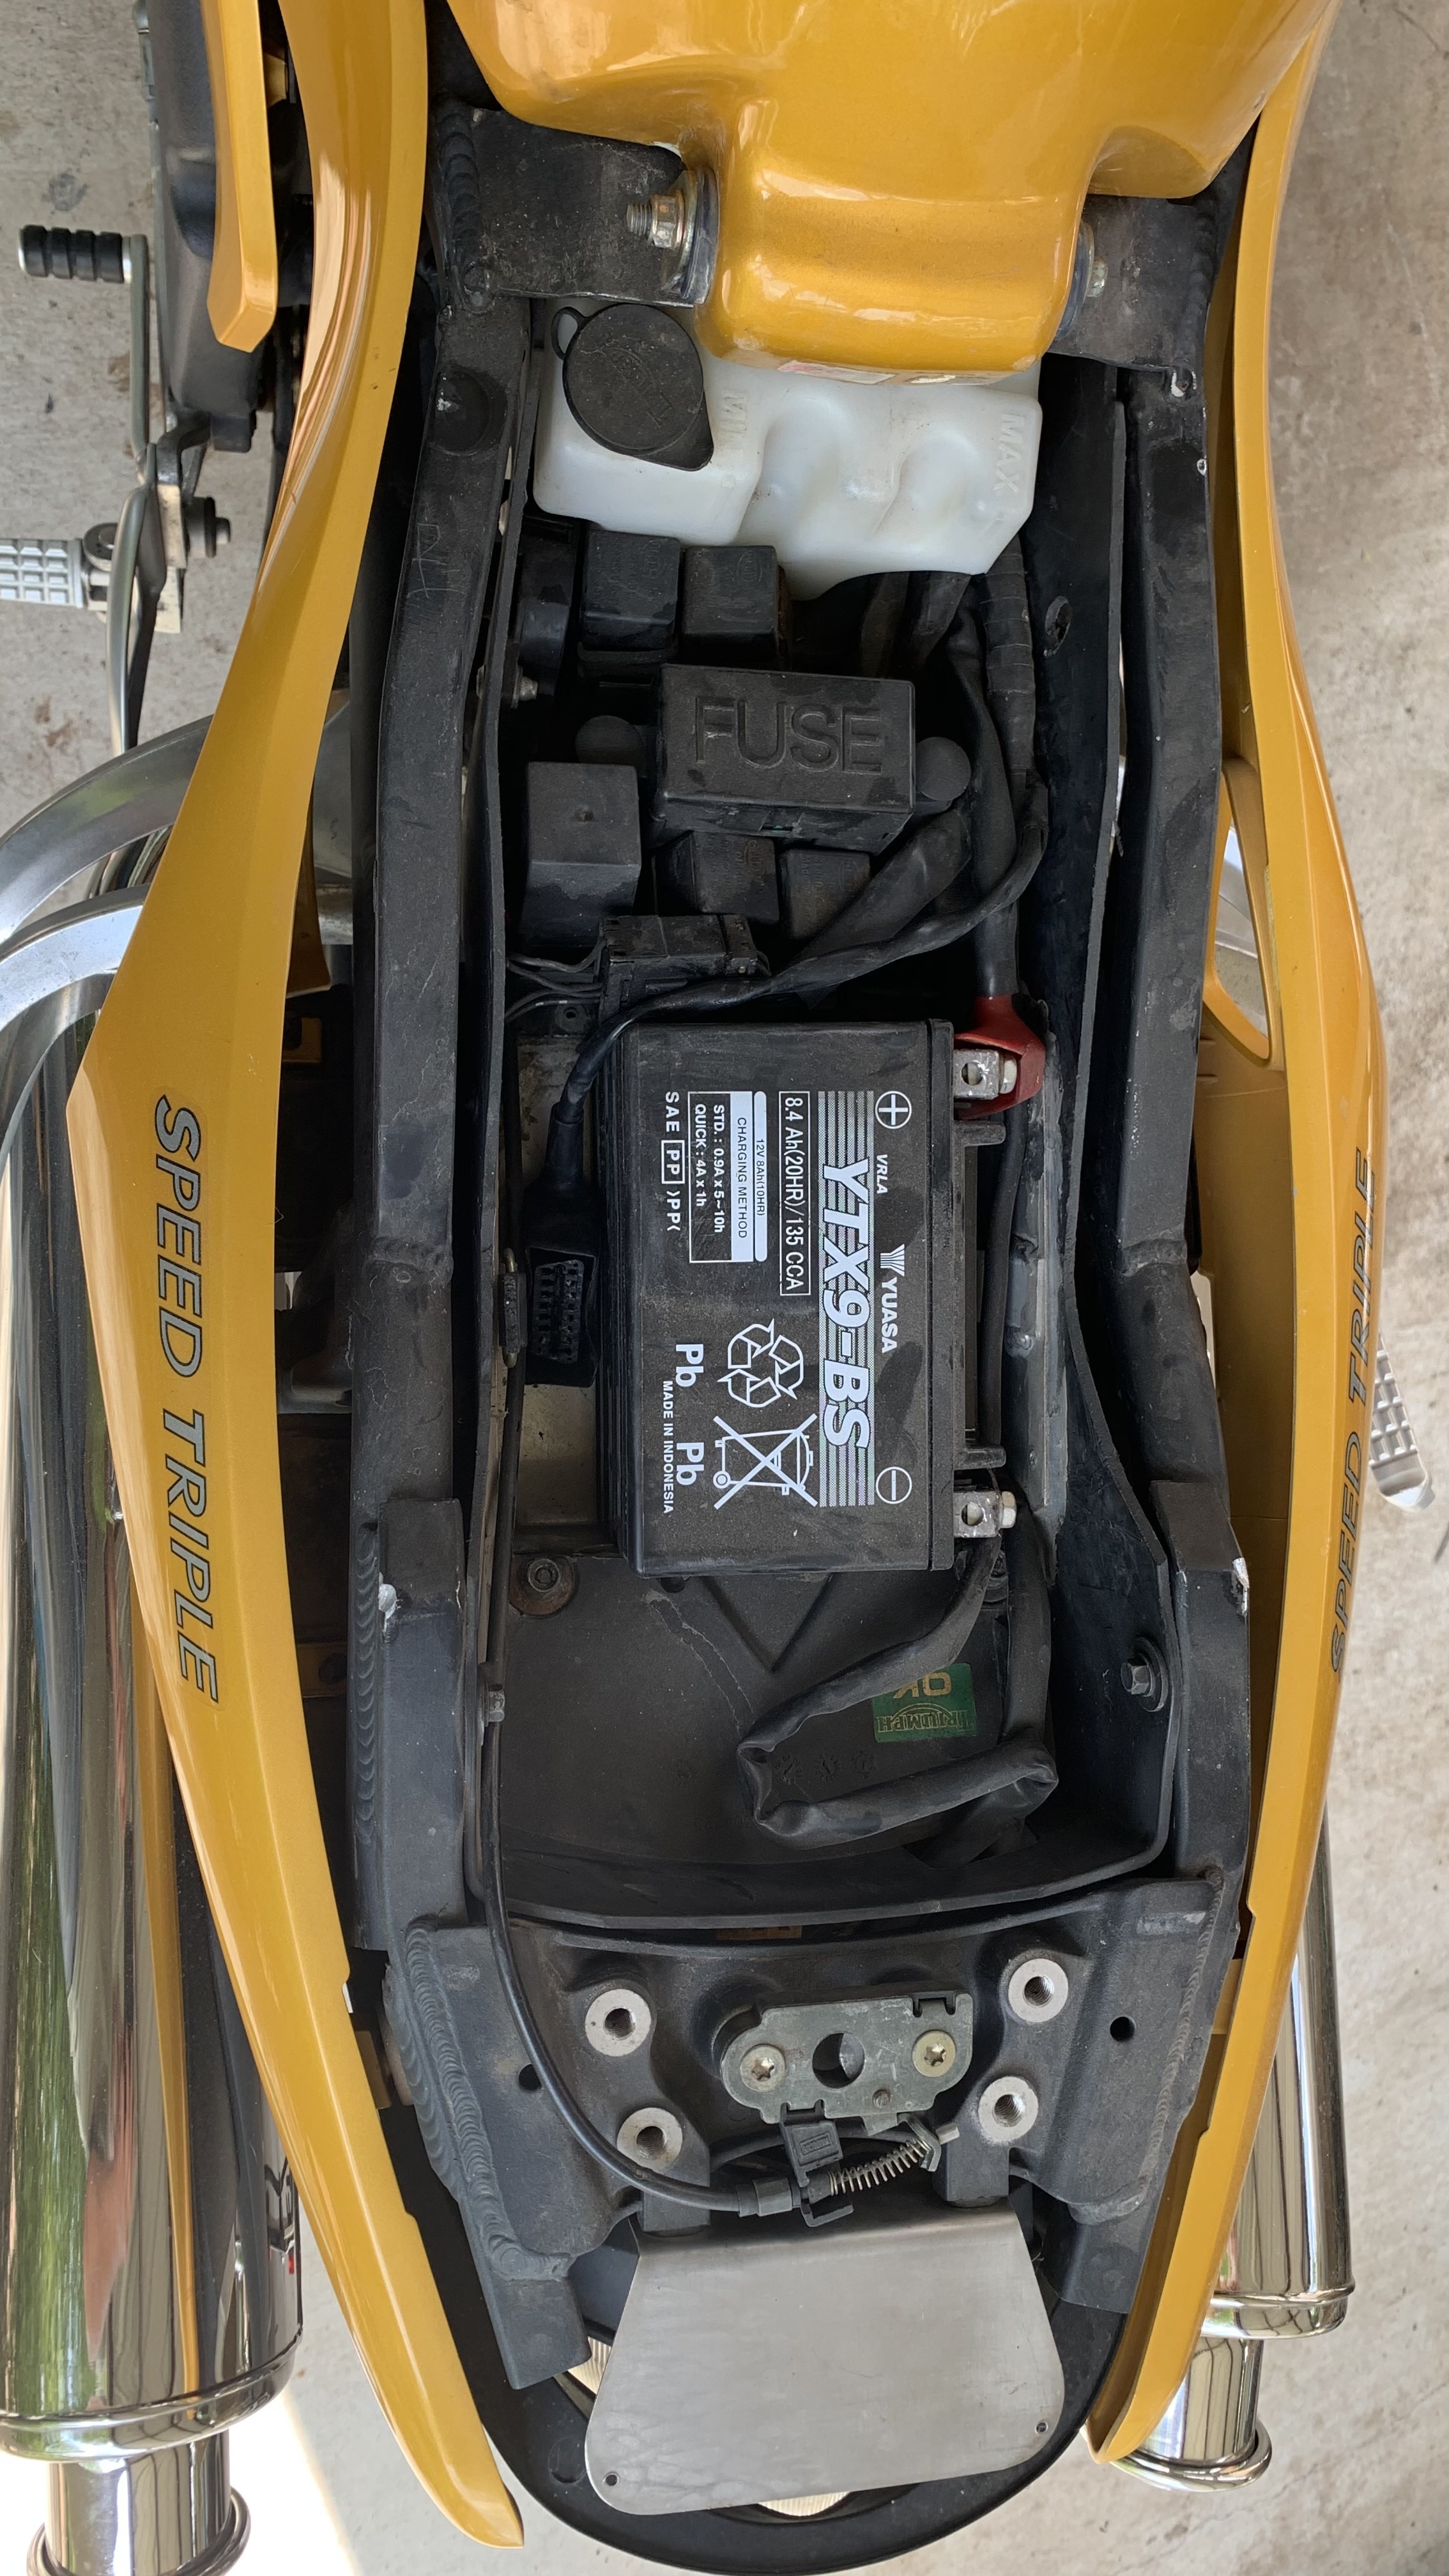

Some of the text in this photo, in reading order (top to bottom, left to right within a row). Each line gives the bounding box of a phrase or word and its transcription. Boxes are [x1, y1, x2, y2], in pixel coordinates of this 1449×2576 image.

[993, 413, 1025, 492] MAX
[694, 696, 883, 776] FUSE
[665, 1091, 680, 1132] SAE
[694, 1103, 707, 1149] QUICK
[713, 1105, 725, 1135] STD.
[785, 1097, 804, 1121] 8.4
[666, 1149, 680, 1175] PP
[696, 1159, 707, 1177] 4A
[713, 1147, 725, 1177] 0.9A
[737, 1117, 747, 1238] CHARGING METHOD
[756, 1138, 765, 1216] 12V 8Ah(10HR)
[876, 1154, 888, 1194] VRLA
[696, 1191, 707, 1207] 1h
[785, 1252, 804, 1291] CCA
[822, 1157, 871, 1449] YTX9-BS
[881, 1276, 898, 1354] YUASA
[675, 1344, 704, 1388] Pb
[154, 1094, 219, 1703] SPEED TRIPLE
[1331, 1146, 1375, 1682] SPEED TRIPLE
[663, 1380, 674, 1514] MADE IN INDONESIA
[676, 1442, 705, 1485] Pb
[876, 1710, 975, 1733] TRIUMPH
